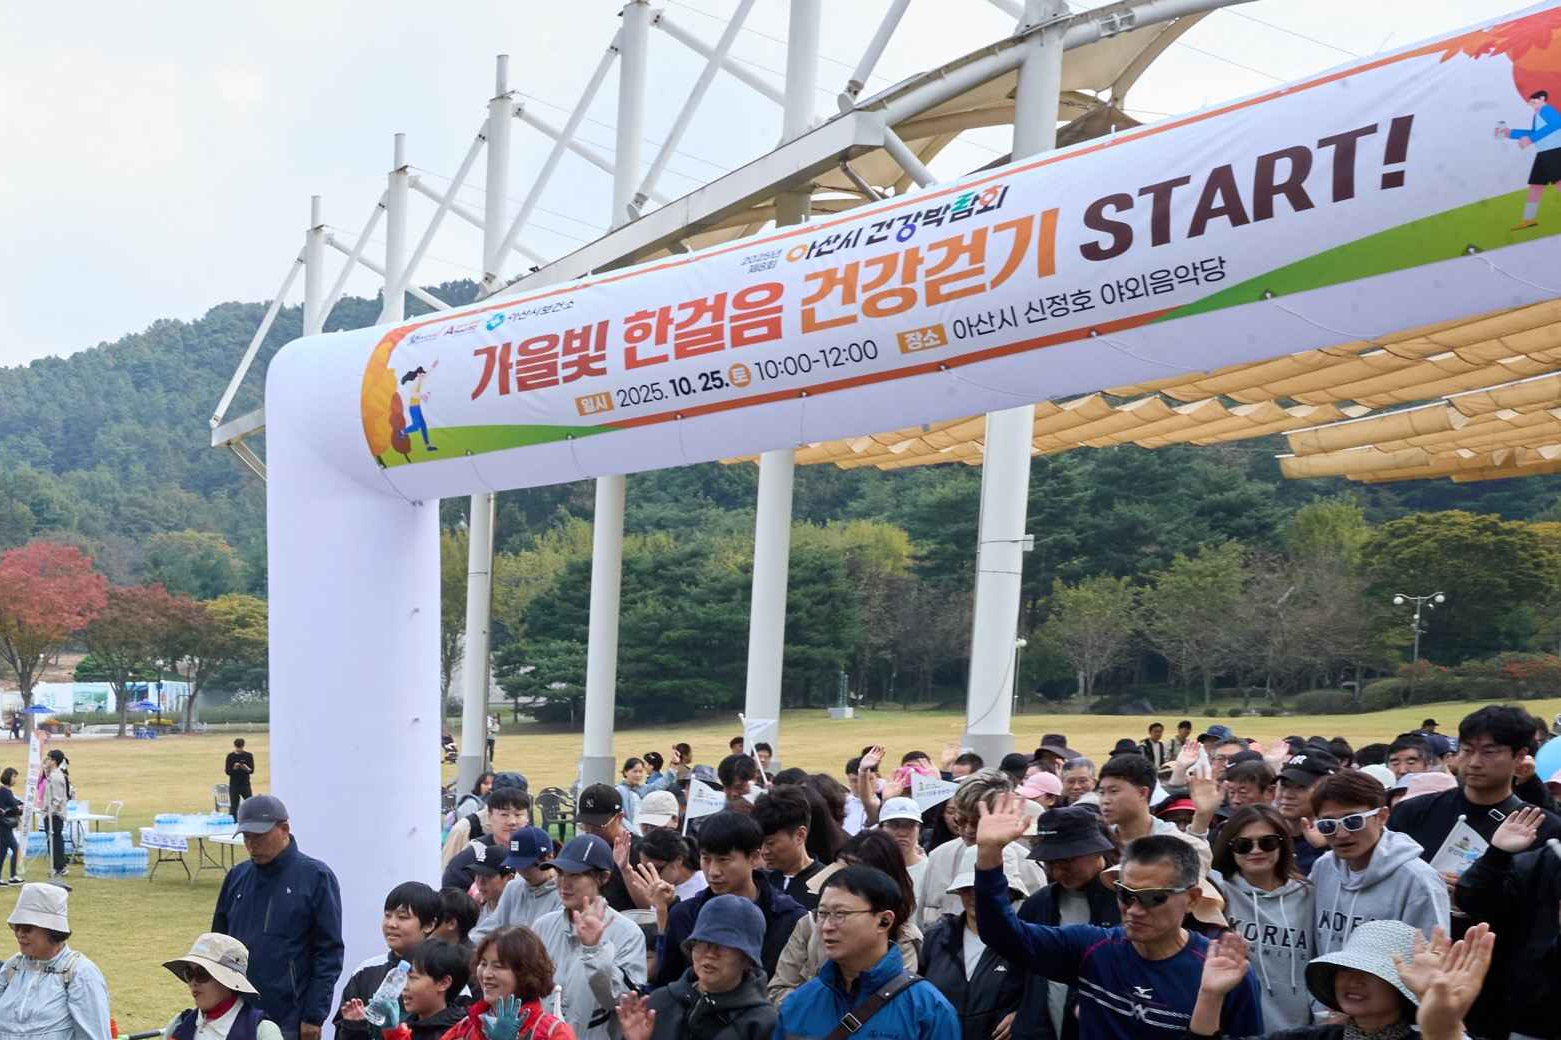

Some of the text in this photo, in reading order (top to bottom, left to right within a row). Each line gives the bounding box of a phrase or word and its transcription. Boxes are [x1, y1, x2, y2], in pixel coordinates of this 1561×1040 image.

[471, 114, 1415, 401] 가을빛 한걸음 건강걷기 START!
[785, 184, 1010, 263] 아산시 건강박람회
[904, 256, 1227, 351] 장소 아산시 신정호 야외음악당
[581, 394, 609, 414] 일시
[754, 339, 879, 381] 10:00-12:00
[1229, 917, 1308, 950] KOREA
